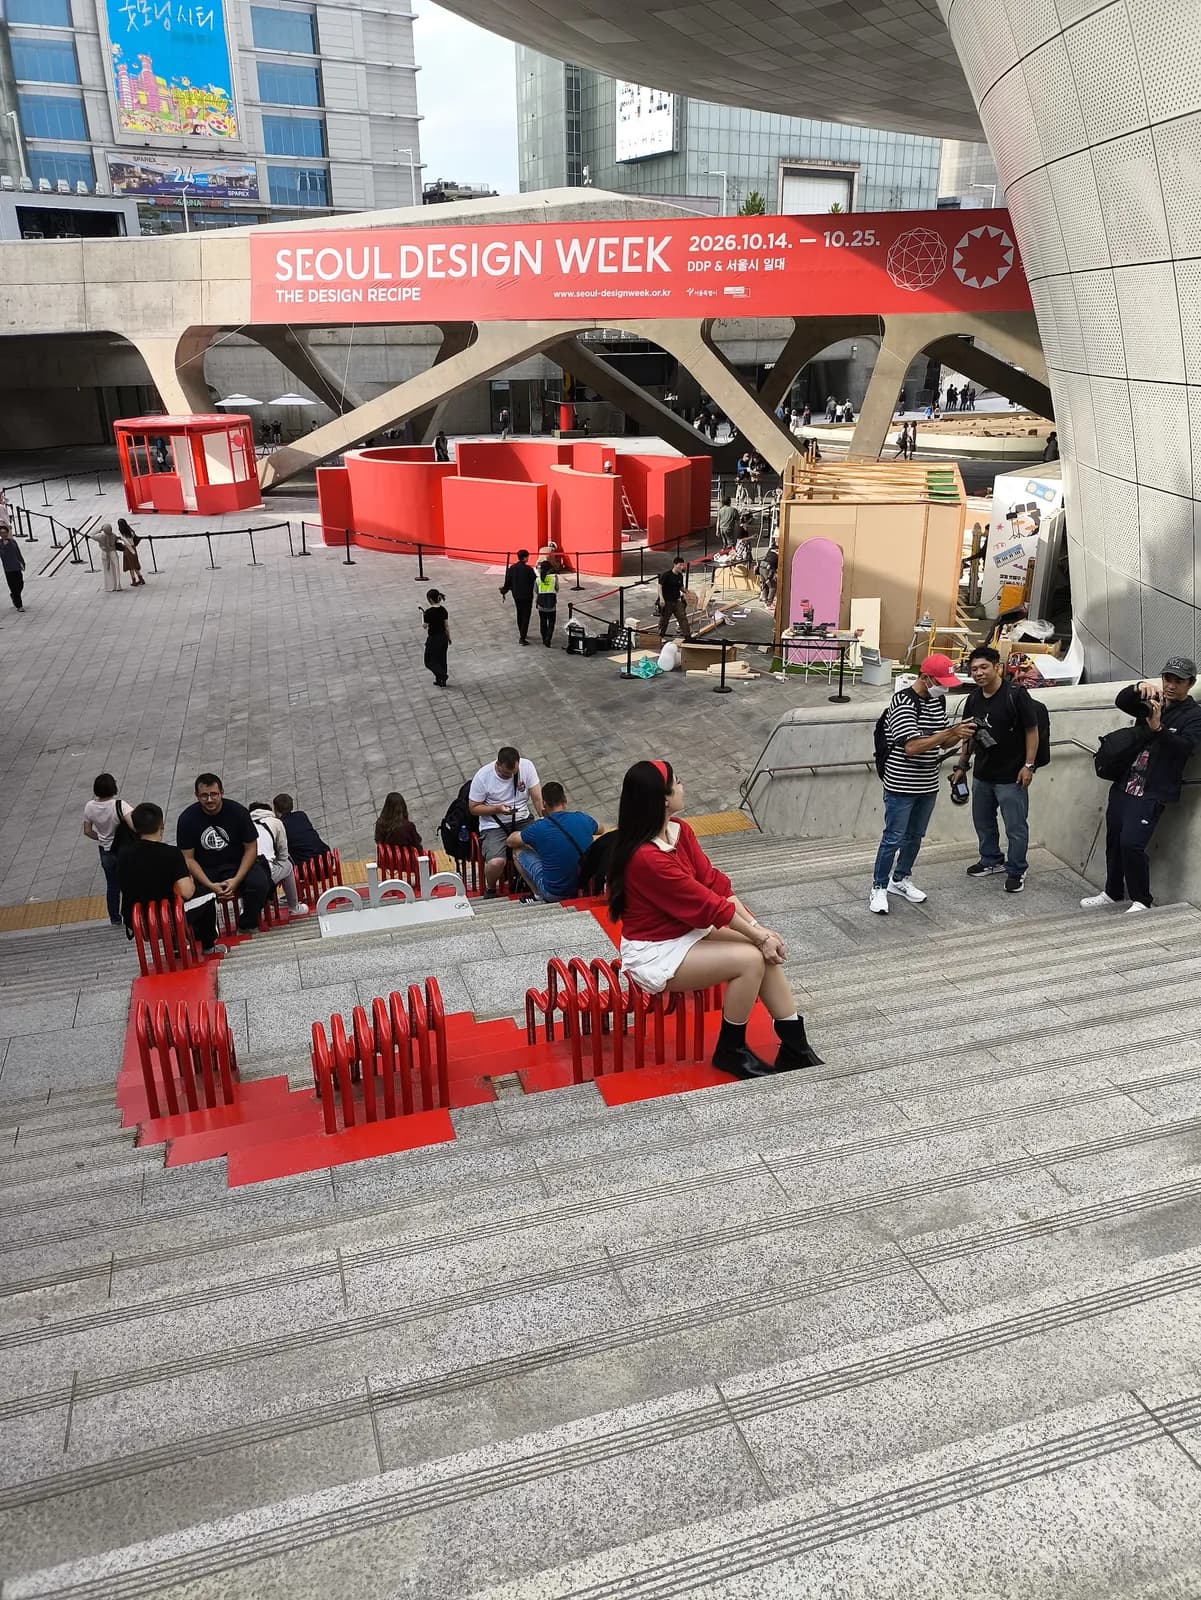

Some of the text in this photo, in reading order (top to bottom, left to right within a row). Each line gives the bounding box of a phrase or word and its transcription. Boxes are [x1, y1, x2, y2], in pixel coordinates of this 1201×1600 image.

[178, 4, 214, 31] 시티
[688, 232, 793, 252] 2026.10.14.
[823, 229, 881, 248] 10.25.
[275, 235, 673, 282] SEOUL DESIGN WEEK
[687, 257, 785, 272] DDP & 서울시 일대
[275, 287, 421, 303] THE DESIGN RECIPE
[552, 288, 672, 299] www.seoul-designweek.or.kr
